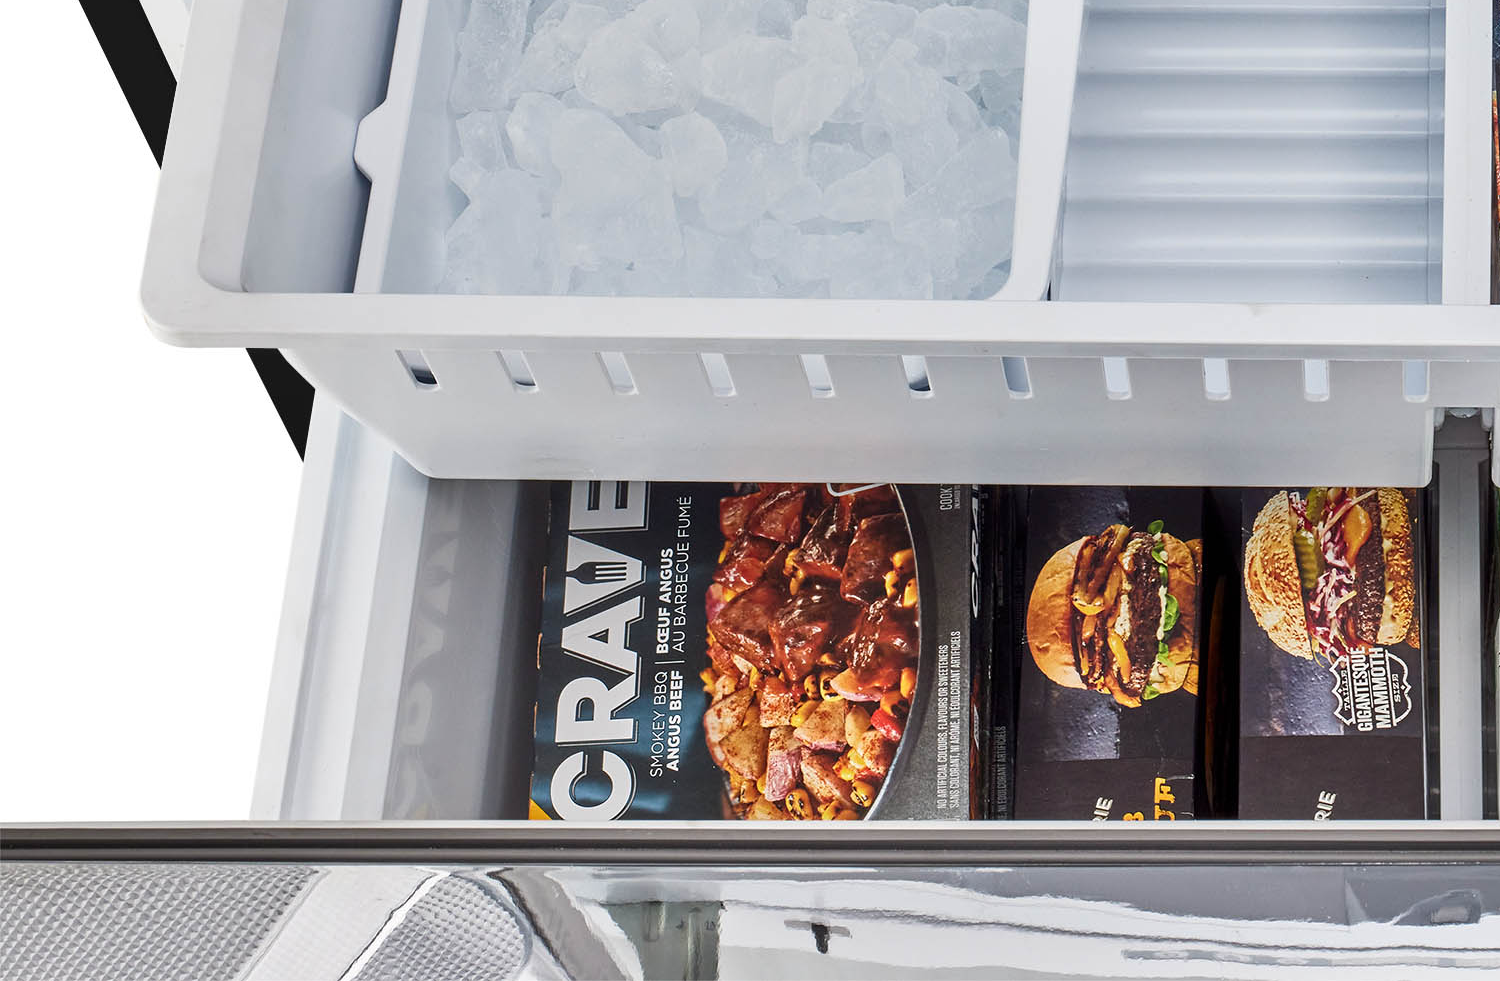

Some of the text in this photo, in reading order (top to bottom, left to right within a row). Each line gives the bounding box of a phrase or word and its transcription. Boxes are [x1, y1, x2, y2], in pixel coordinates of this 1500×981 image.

[939, 487, 953, 510] COOK
[971, 484, 979, 619] CRA
[672, 496, 692, 653] AU BARBECUE FUMÉ
[656, 548, 674, 654] BŒUF ANGUS
[550, 480, 650, 820] CRAVE
[938, 645, 949, 687] SWEETENERS
[950, 631, 961, 668] ARTIFICIELS
[938, 687, 949, 697] OR
[1340, 669, 1351, 711] TAILLE
[1350, 646, 1374, 732] GIGANTESQUE
[1368, 647, 1392, 729] MAMMOTH
[1391, 673, 1402, 703] SIZE
[649, 671, 668, 777] SMOKEY BBQ
[666, 670, 683, 772] ANGUS BEEF
[938, 697, 949, 730] FLAVOURS
[950, 745, 960, 753] NI
[937, 763, 948, 798] ARTIFICIAL
[950, 789, 960, 808] SANS
[937, 798, 948, 809] NO
